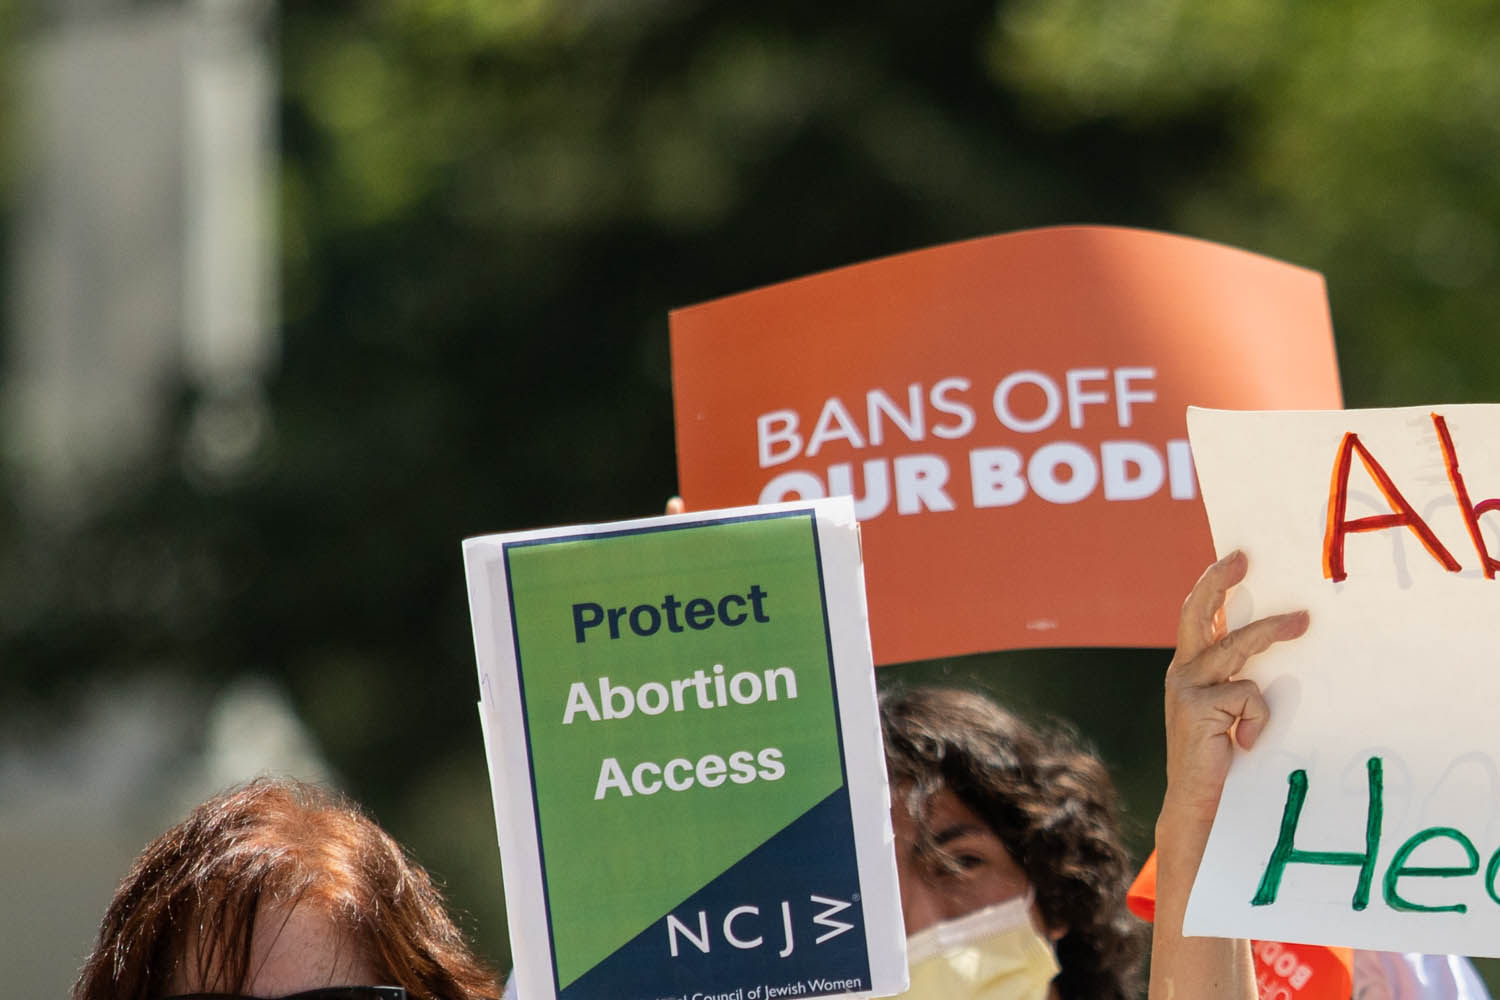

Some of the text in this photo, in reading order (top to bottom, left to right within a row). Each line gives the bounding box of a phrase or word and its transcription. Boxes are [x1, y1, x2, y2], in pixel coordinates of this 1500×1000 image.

[755, 366, 1158, 470] BANS OFF
[757, 439, 1197, 522] OUR BODI
[571, 583, 771, 644] Protect
[561, 662, 799, 725] Abortion
[593, 746, 786, 801] Access
[666, 893, 856, 959] NCJW
[763, 978, 807, 1000] Jewish
[808, 976, 862, 996] Women
